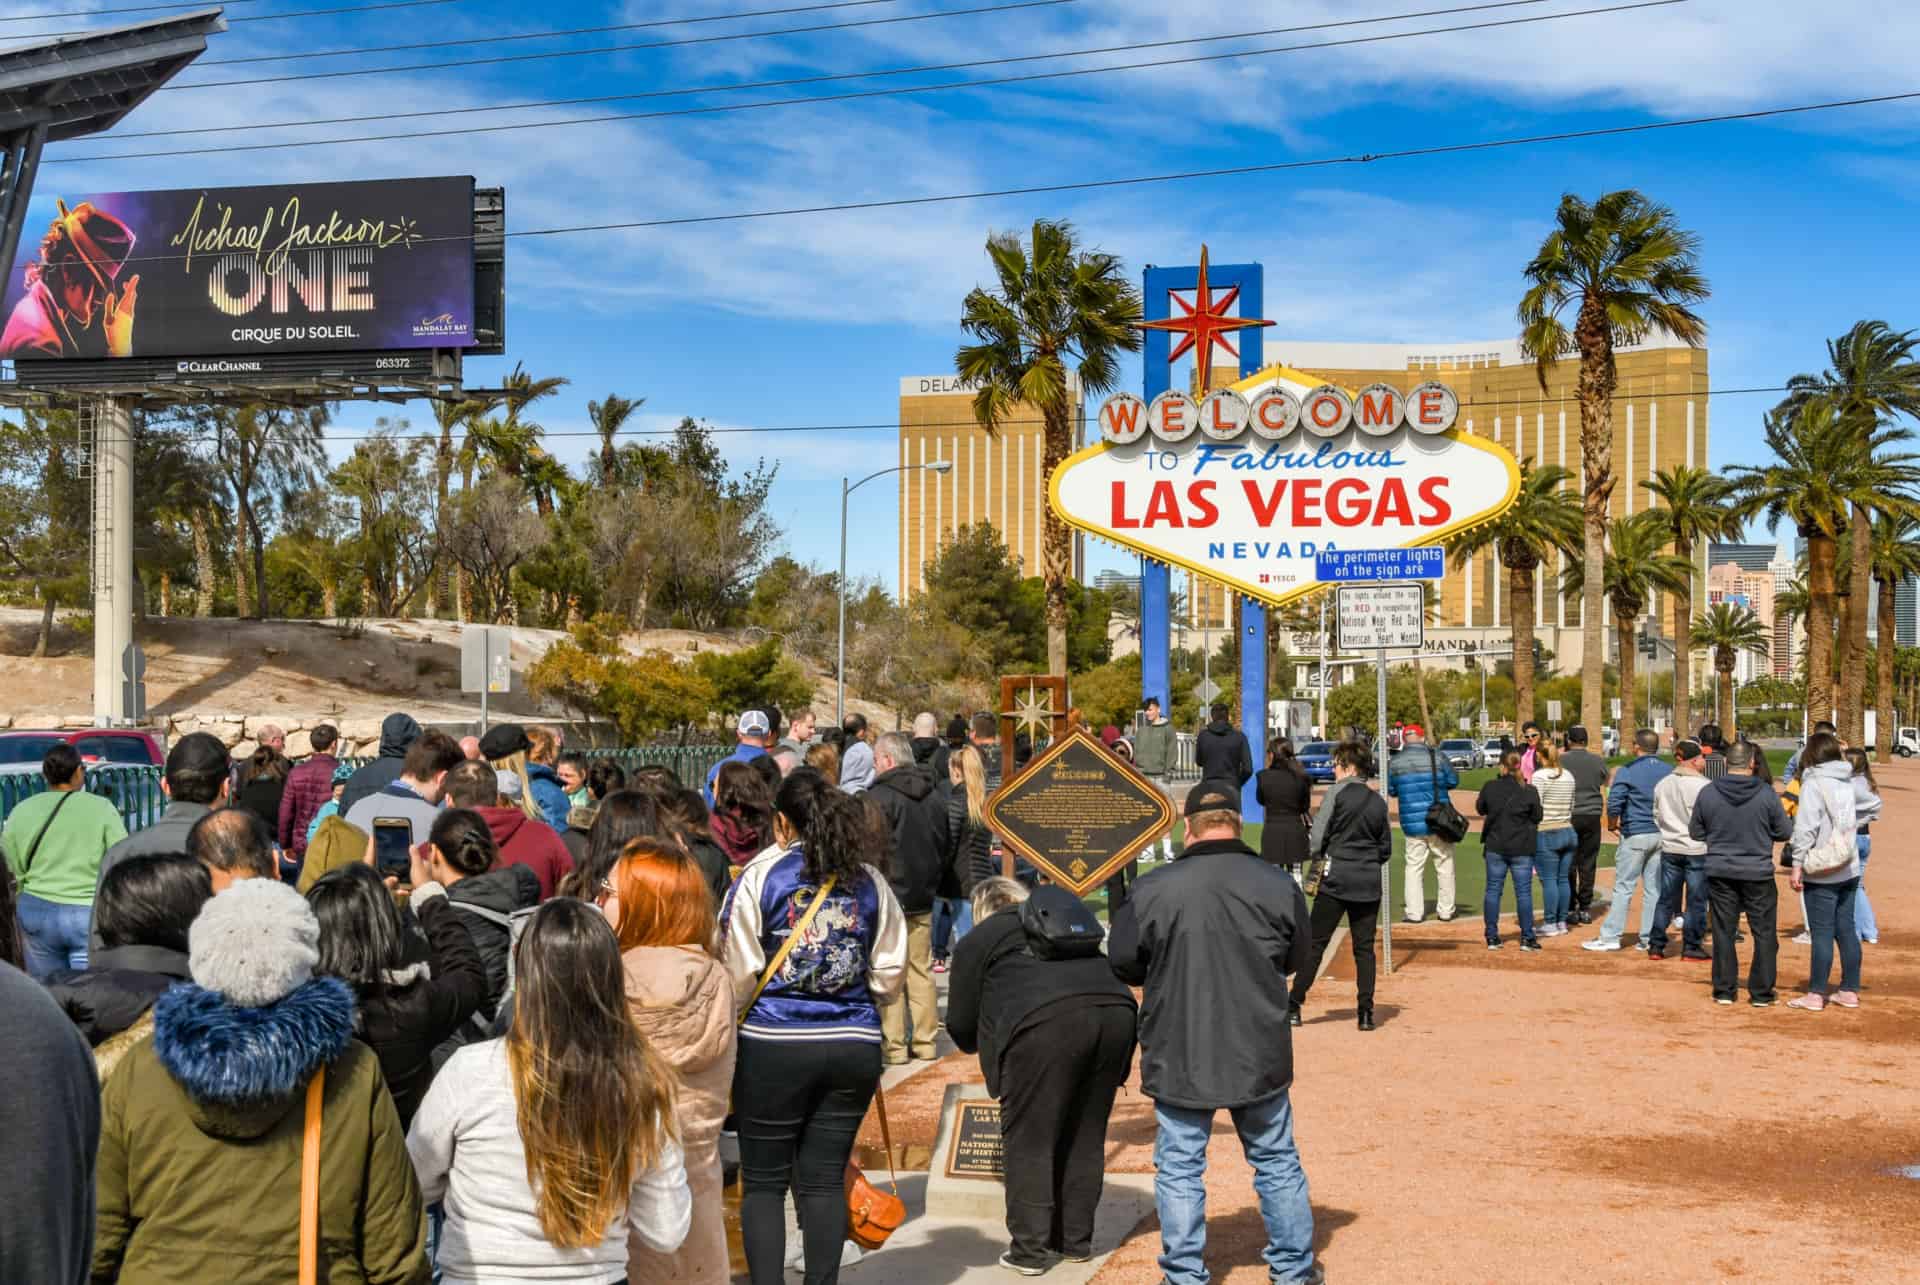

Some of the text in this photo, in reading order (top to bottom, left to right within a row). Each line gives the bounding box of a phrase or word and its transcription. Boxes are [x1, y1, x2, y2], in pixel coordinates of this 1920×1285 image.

[171, 192, 402, 275] Michael Jackson
[209, 248, 374, 316] ONE
[232, 328, 282, 344] CIRQUE
[286, 327, 306, 339] DU
[375, 358, 411, 369] 063372
[1106, 391, 1444, 434] WELCOME
[1143, 440, 1407, 475] TO Fabulous
[1111, 476, 1452, 528] LAS VEGAS
[1319, 549, 1441, 566] The perimeter lights
[1335, 564, 1424, 578] on the sign are
[1354, 603, 1370, 613] RED
